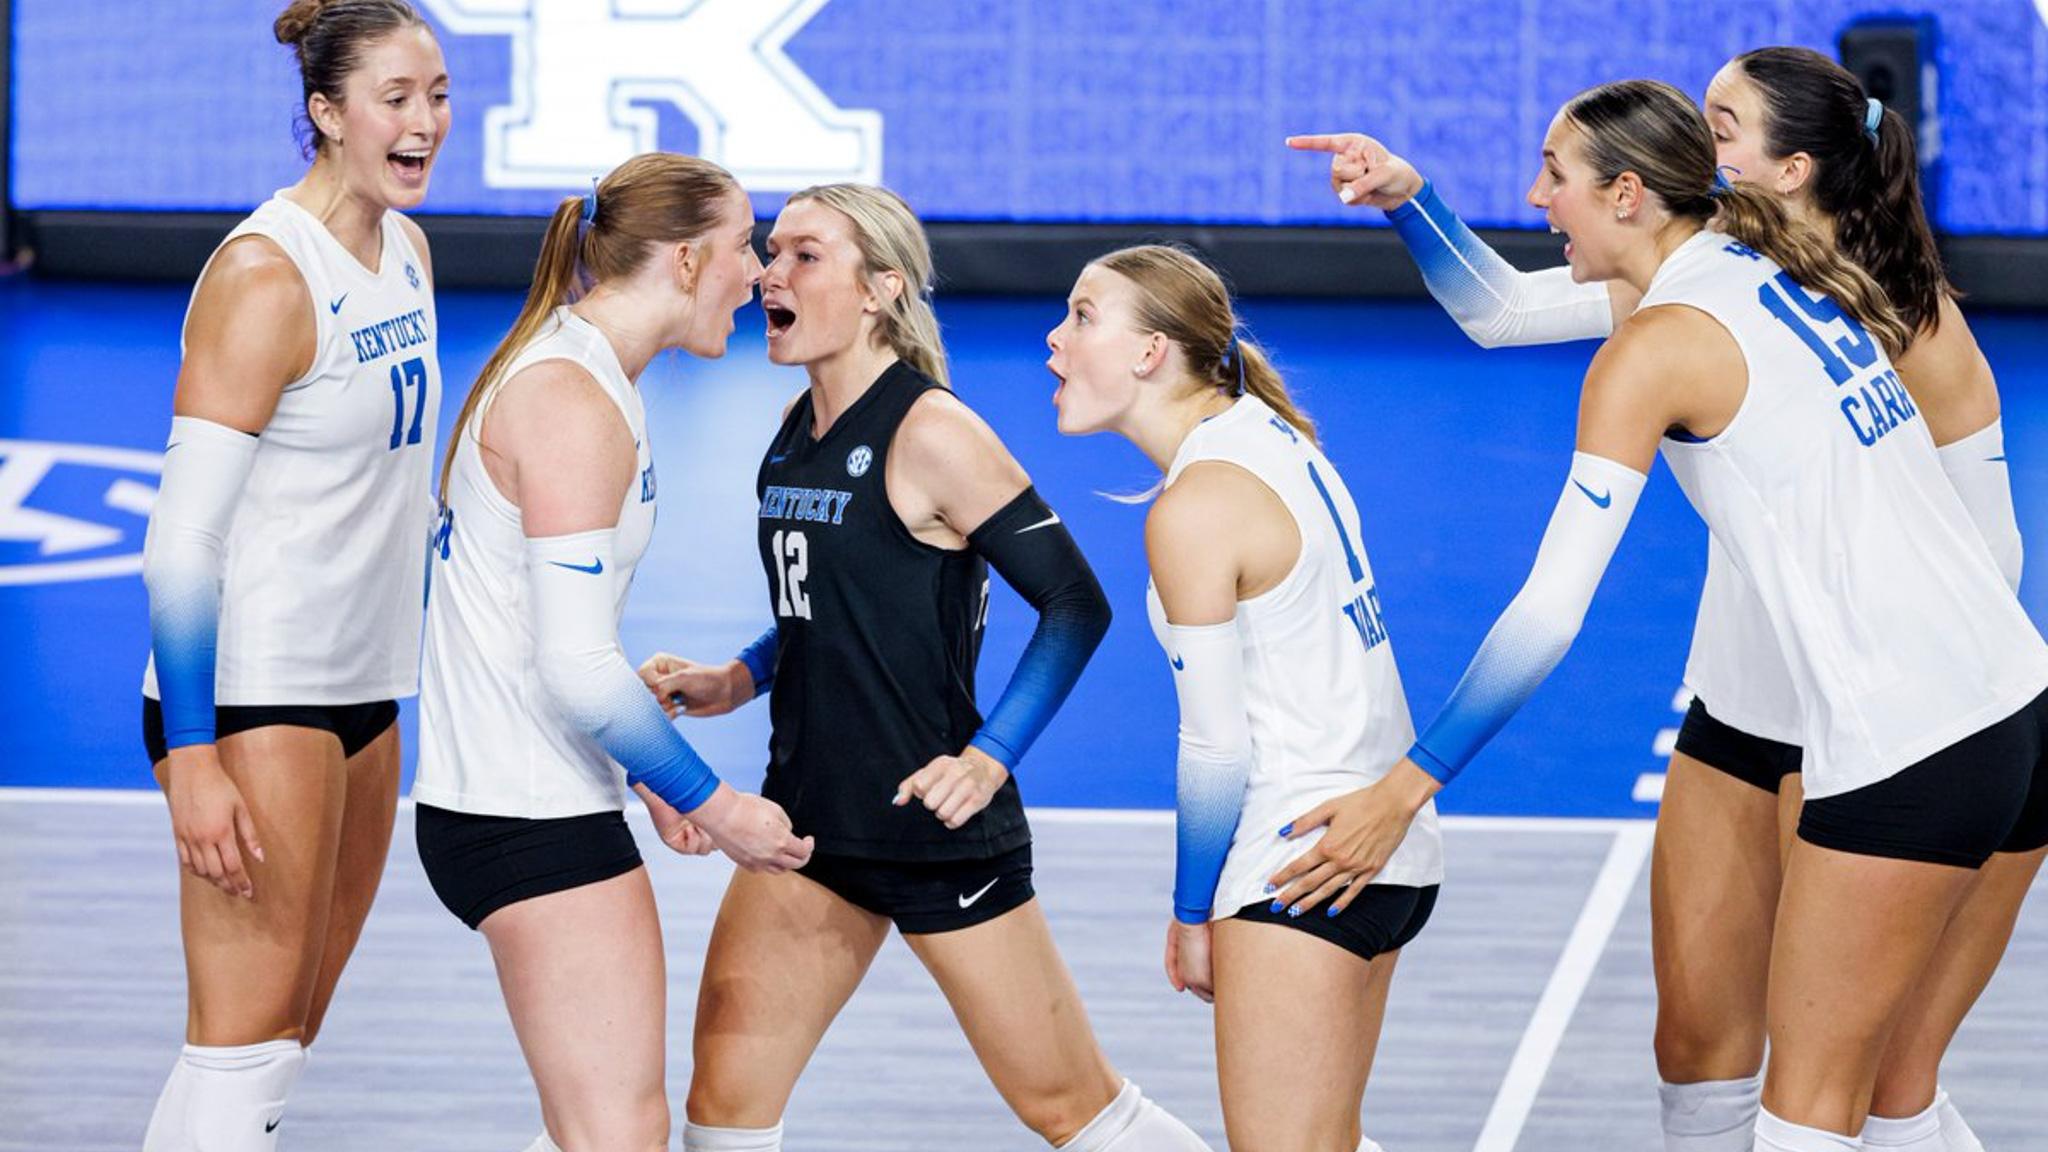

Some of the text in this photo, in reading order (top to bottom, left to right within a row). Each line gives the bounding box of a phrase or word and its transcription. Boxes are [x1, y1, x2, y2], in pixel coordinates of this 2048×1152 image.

[1758, 268, 1878, 386] 15
[390, 356, 427, 450] 17
[772, 530, 812, 620] 12
[1307, 461, 1363, 584] 1
